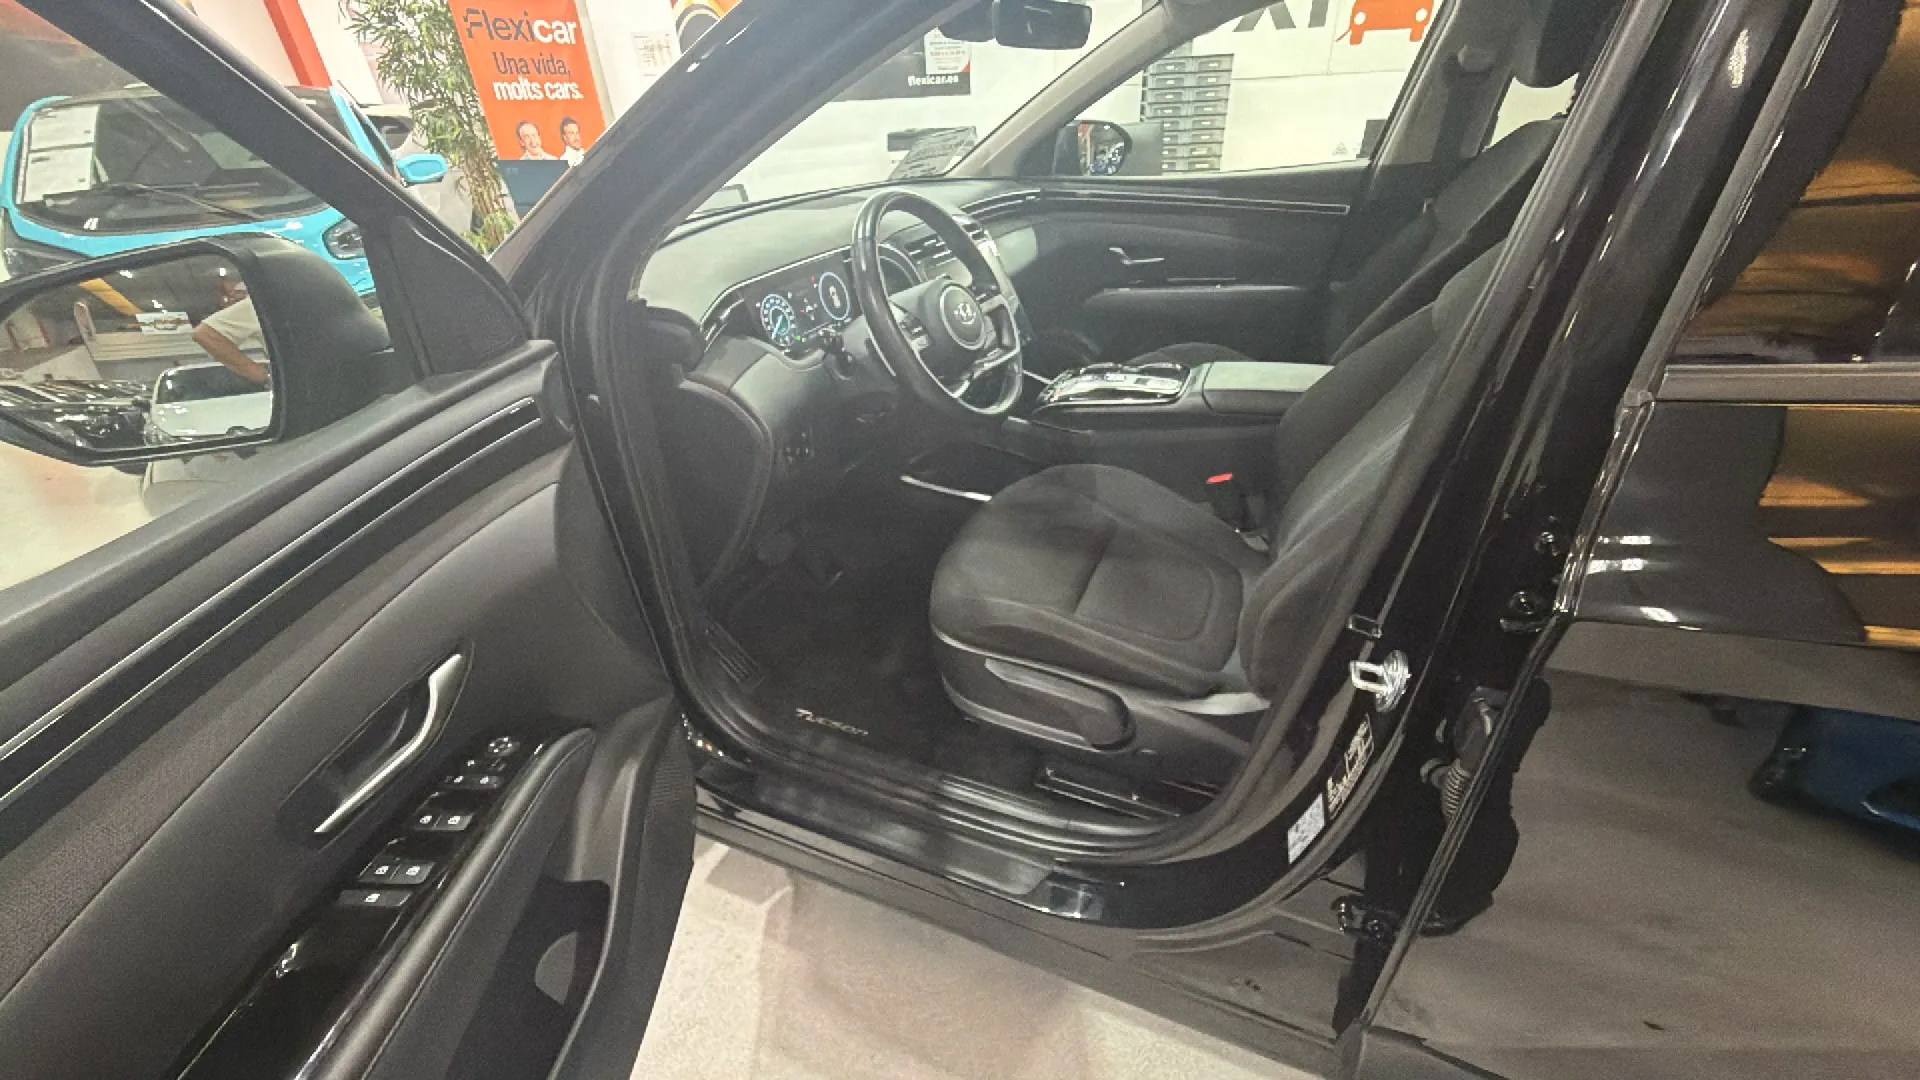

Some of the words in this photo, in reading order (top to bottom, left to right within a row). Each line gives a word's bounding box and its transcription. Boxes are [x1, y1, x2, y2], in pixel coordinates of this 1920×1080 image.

[463, 8, 577, 44] Flexicar
[492, 52, 530, 75] Una
[531, 52, 571, 79] vida,
[493, 76, 543, 100] molts
[544, 81, 584, 100] cars.
